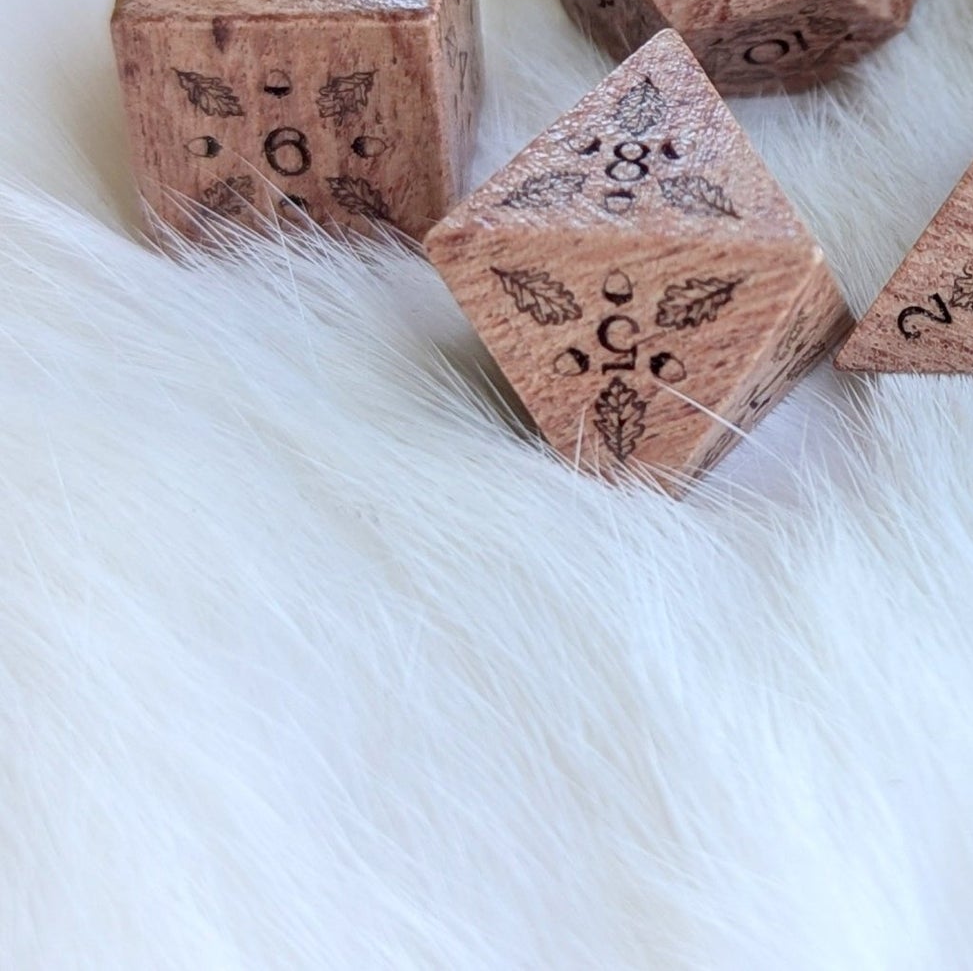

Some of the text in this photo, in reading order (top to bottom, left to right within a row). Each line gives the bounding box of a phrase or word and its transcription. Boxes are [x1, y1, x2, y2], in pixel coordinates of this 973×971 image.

[743, 30, 810, 65] 10
[264, 127, 312, 176] 6
[605, 140, 650, 182] 8
[898, 293, 954, 340] 2
[597, 313, 640, 376] 5
